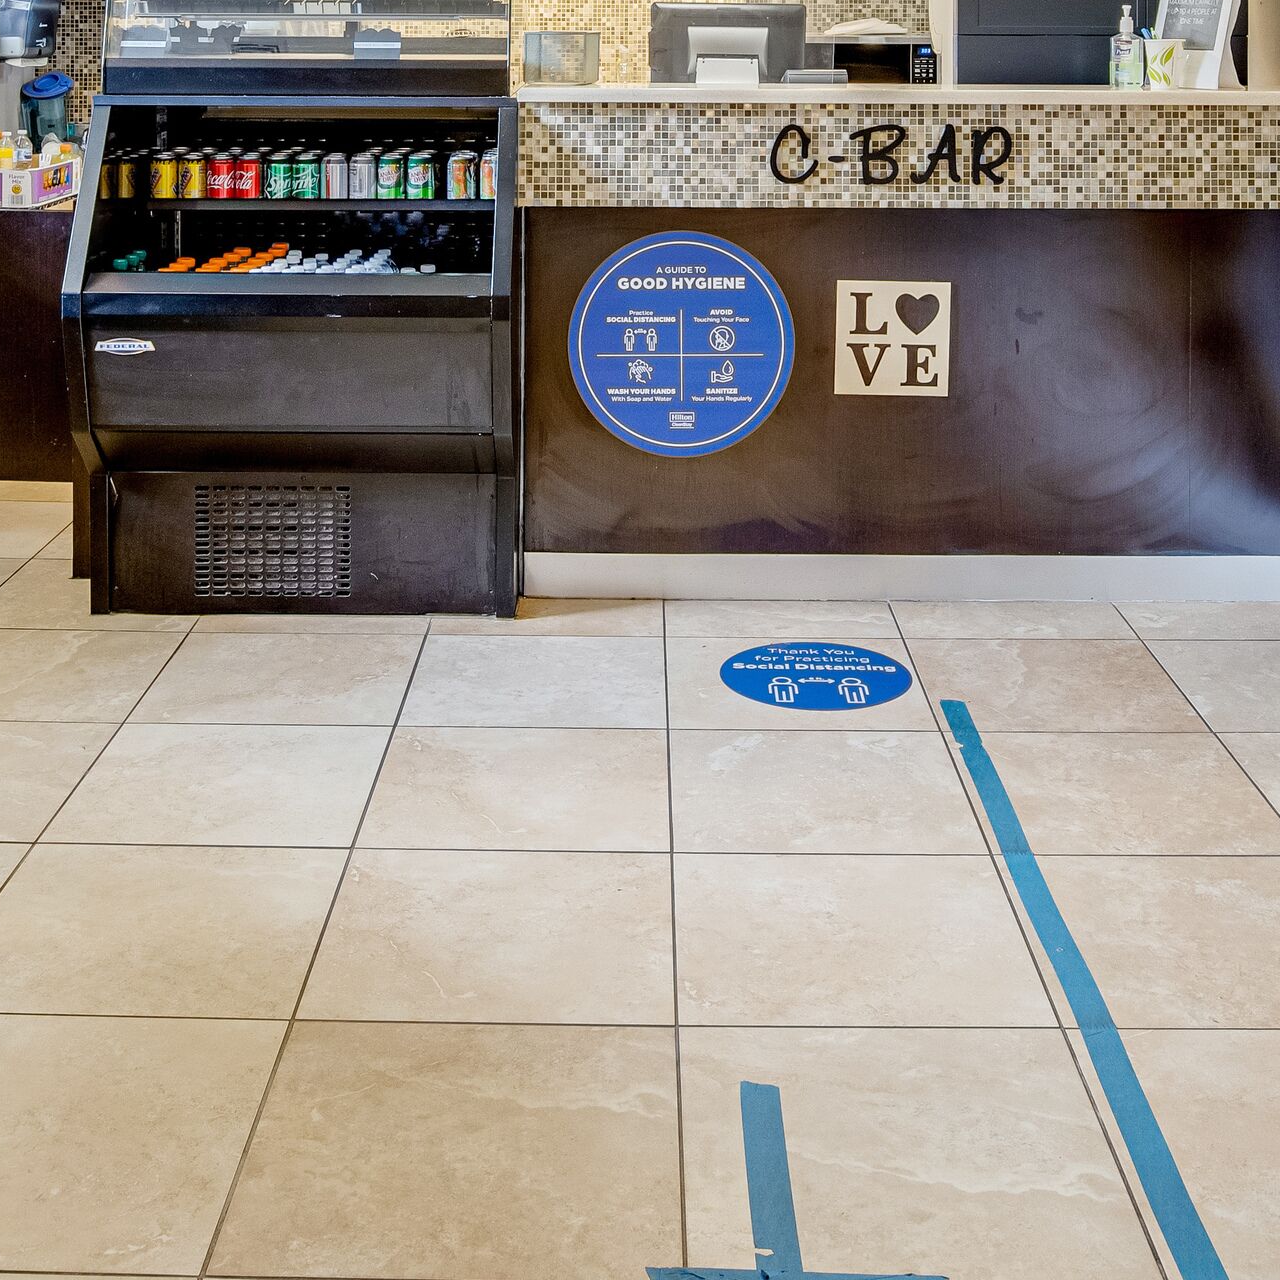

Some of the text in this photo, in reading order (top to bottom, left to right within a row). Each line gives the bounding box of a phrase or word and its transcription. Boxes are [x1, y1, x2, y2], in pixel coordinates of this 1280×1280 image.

[770, 124, 1012, 185] C-BAR
[617, 276, 746, 290] GOOD HYGIENE
[784, 655, 870, 664] Practicing
[732, 663, 896, 673] Social Distancing
